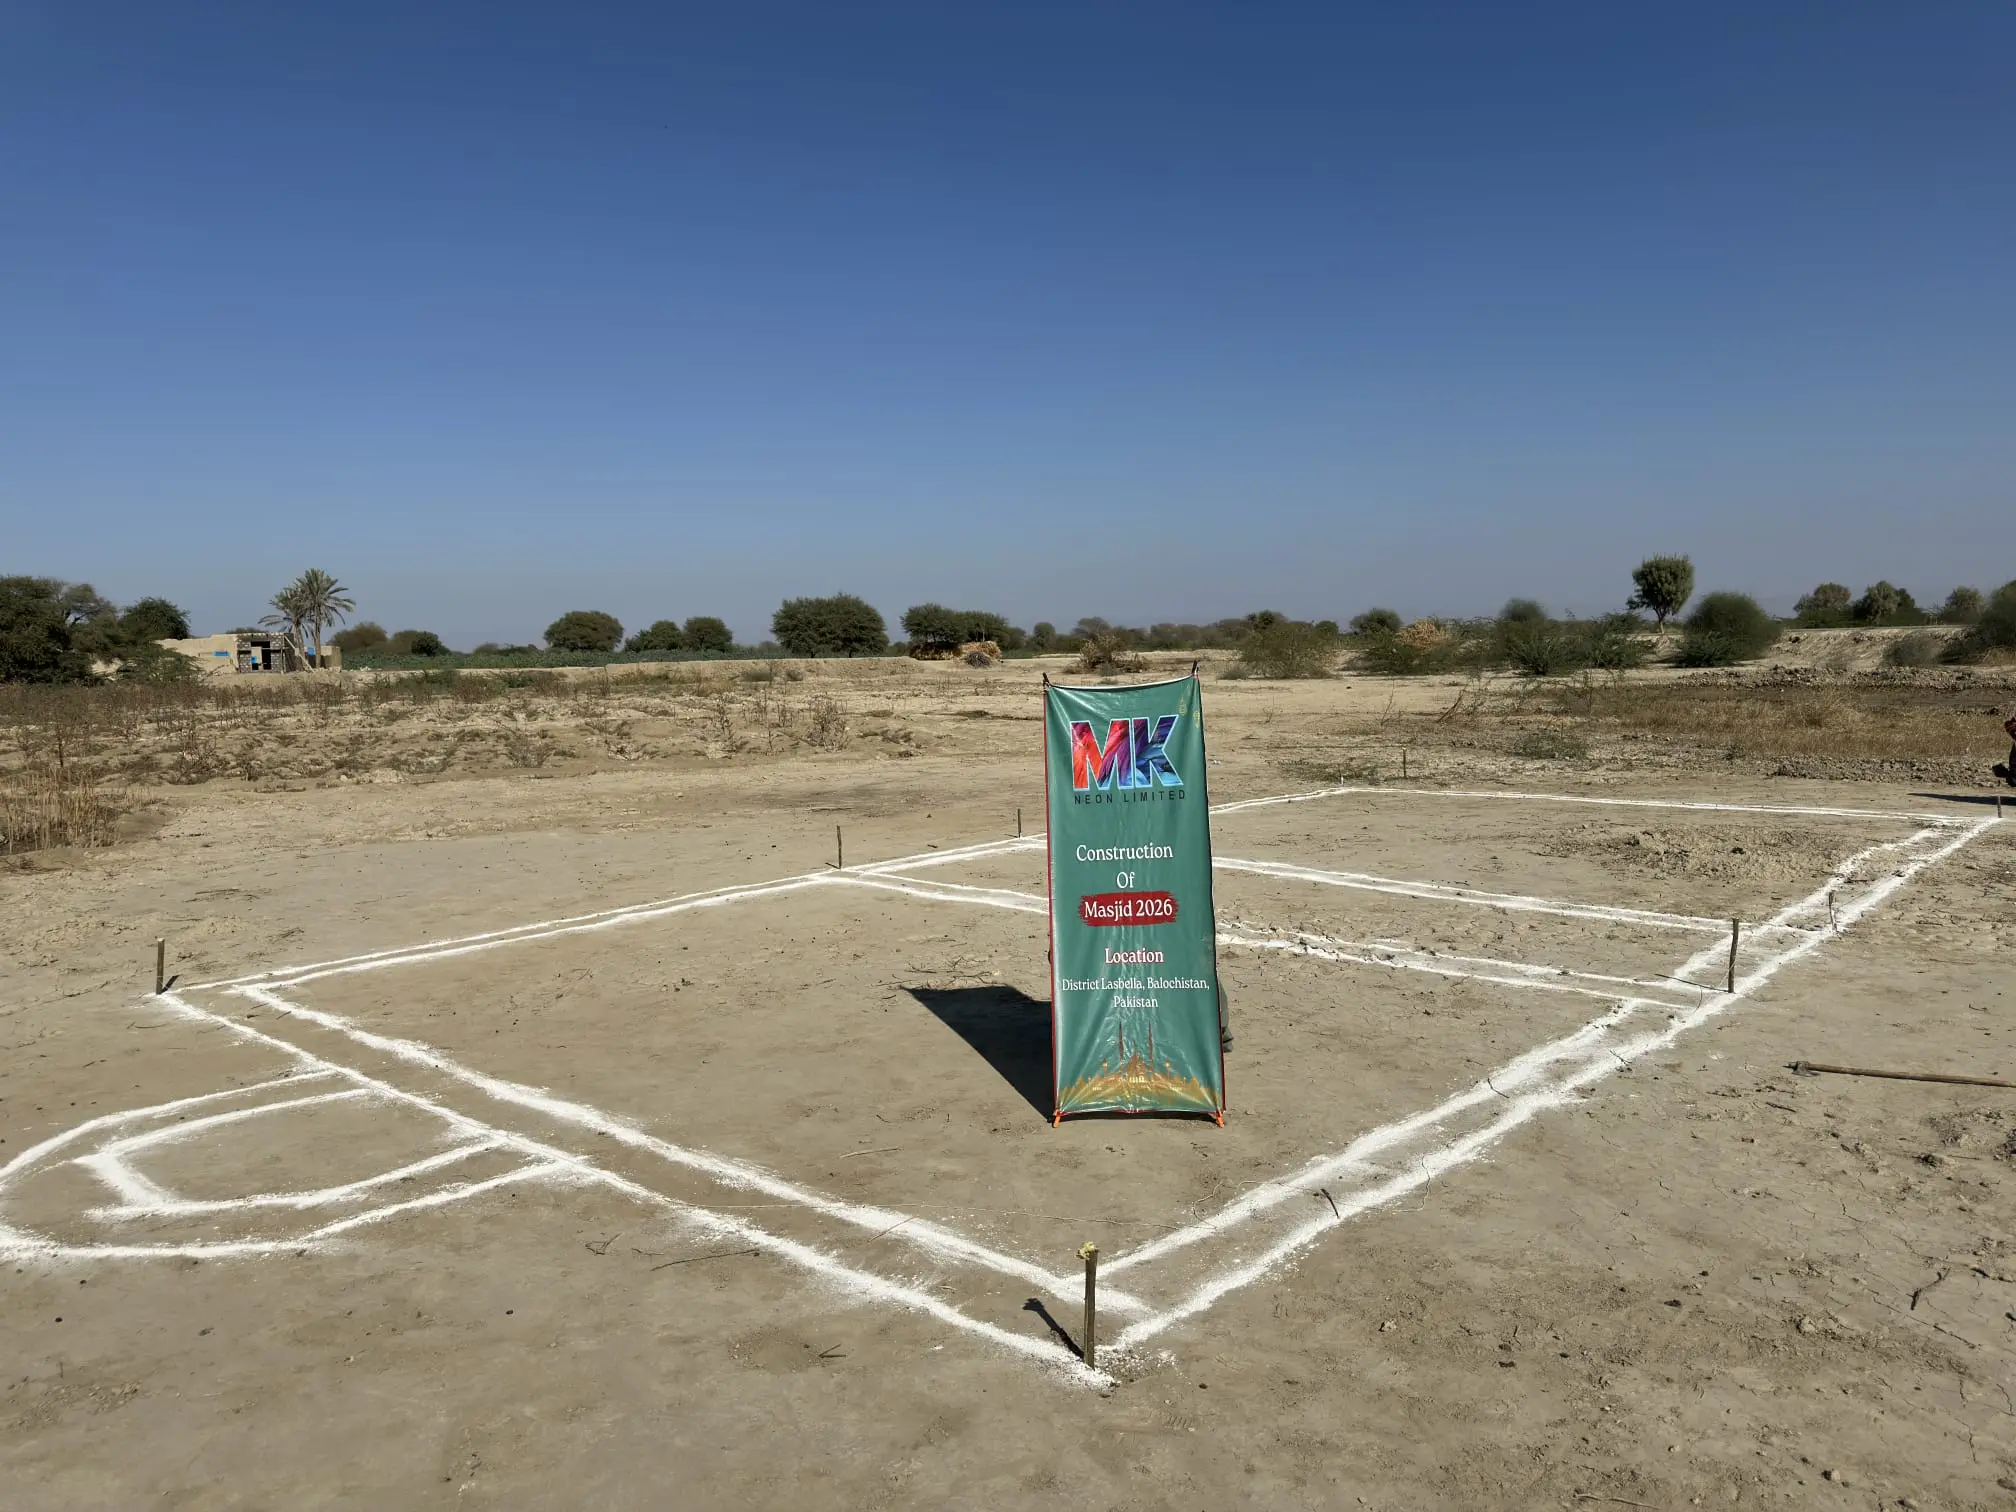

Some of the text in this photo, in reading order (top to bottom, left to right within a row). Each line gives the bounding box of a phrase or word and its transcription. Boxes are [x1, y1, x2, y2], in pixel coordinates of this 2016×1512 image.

[1070, 714, 1184, 792] MK
[1074, 789, 1185, 805] NEON LIMITED
[1076, 842, 1173, 862] Construction
[1116, 871, 1135, 889] Of
[1084, 898, 1173, 922] Masjid 2026
[1104, 948, 1164, 964] Location
[1062, 976, 1210, 991] District Lasbella, Balochistan,
[1113, 995, 1159, 1008] Pakistan
